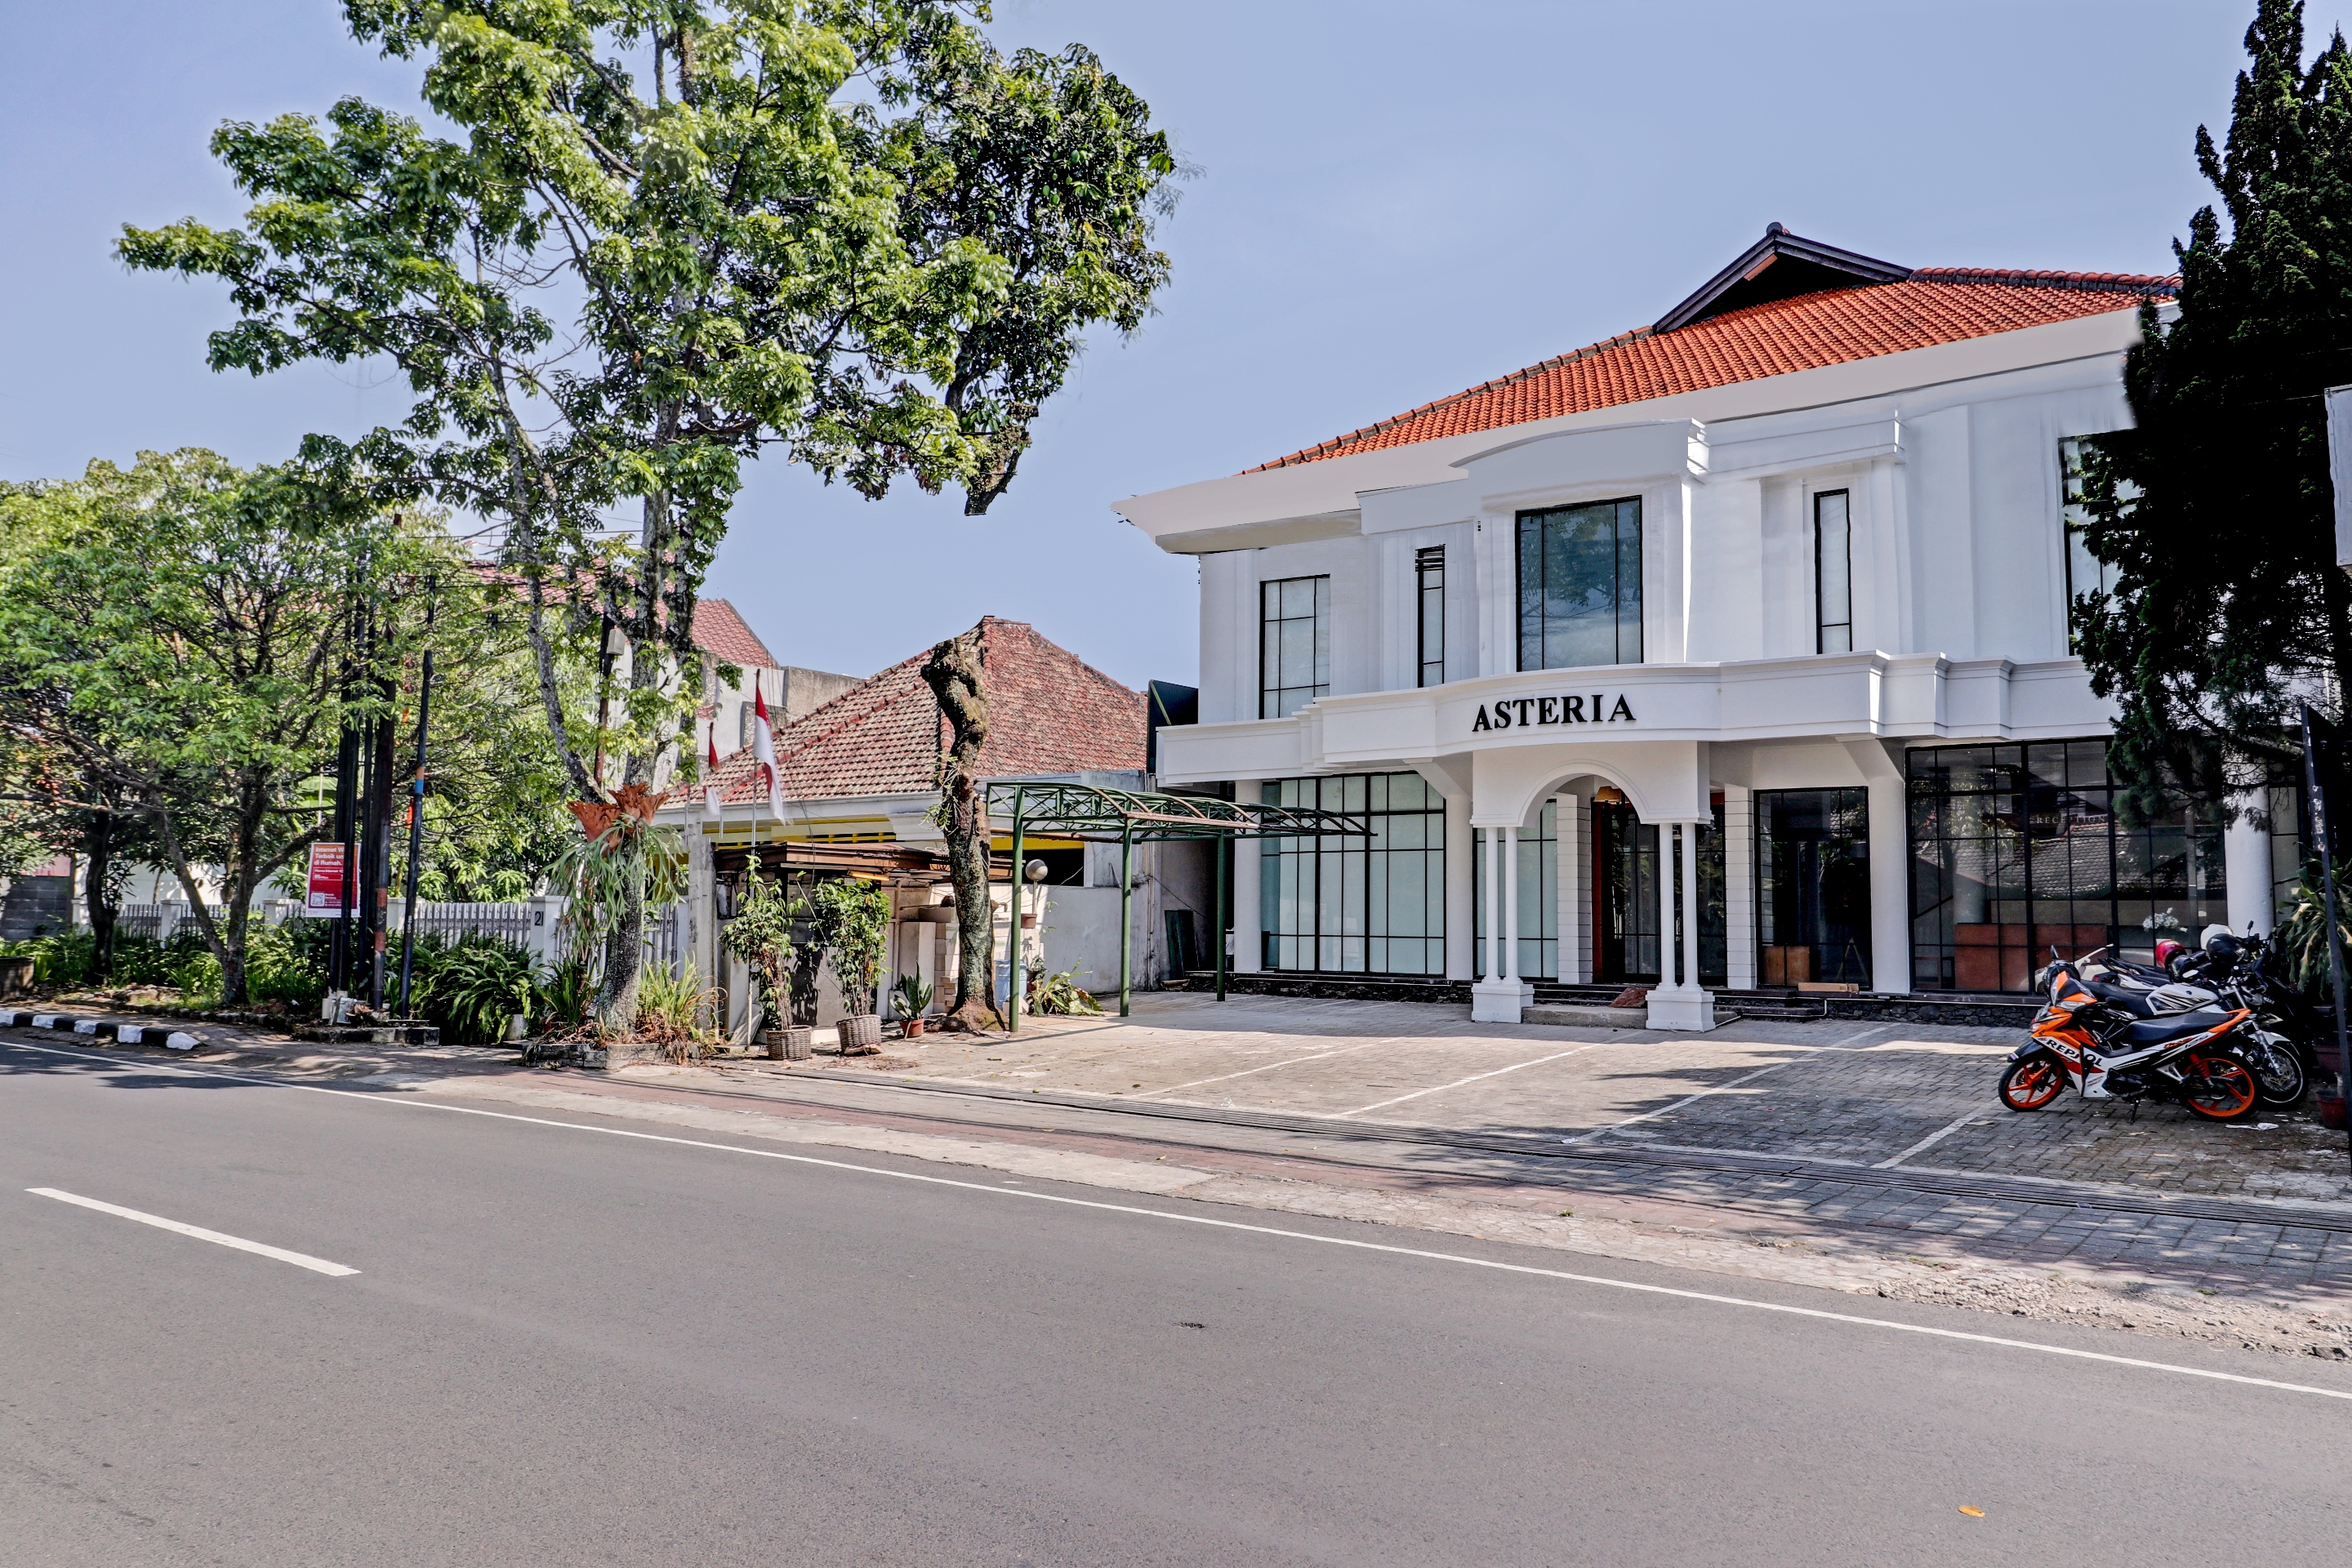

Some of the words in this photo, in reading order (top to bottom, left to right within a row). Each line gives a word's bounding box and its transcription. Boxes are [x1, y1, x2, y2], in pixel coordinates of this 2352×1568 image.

[1472, 693, 1636, 732] ASTERIA
[2037, 816, 2105, 824] RECEPTION
[534, 911, 544, 926] 21
